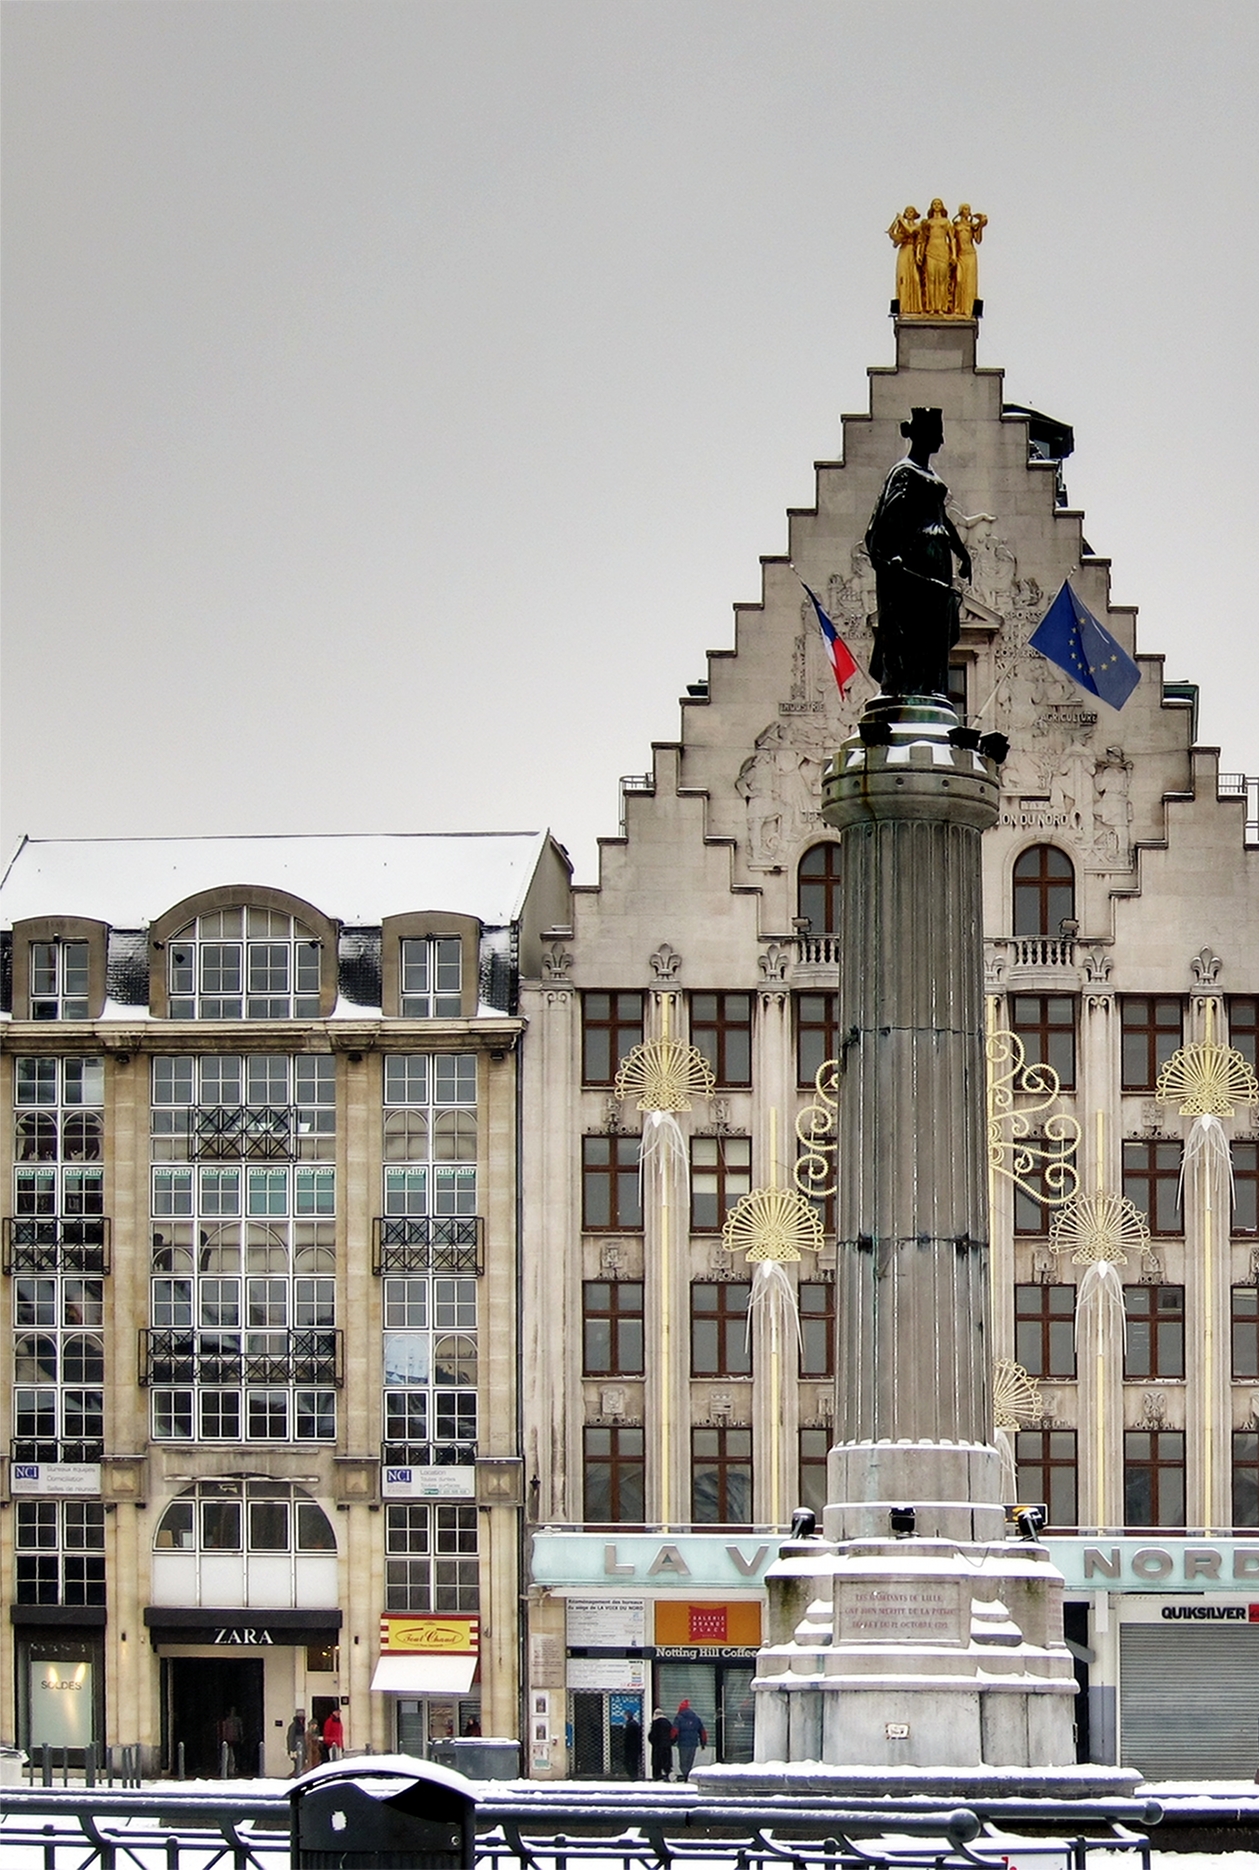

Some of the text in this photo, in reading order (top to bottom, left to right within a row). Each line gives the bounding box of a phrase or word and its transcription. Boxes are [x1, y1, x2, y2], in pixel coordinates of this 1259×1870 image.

[15, 1465, 39, 1479] NCI
[387, 1469, 411, 1482] NCI
[604, 1543, 692, 1576] LA
[1161, 1606, 1247, 1620] QUIKSILVER
[213, 1627, 275, 1645] ZARA
[655, 1648, 758, 1660] Notting Hill Coffee
[40, 1680, 83, 1691] SOLDES
